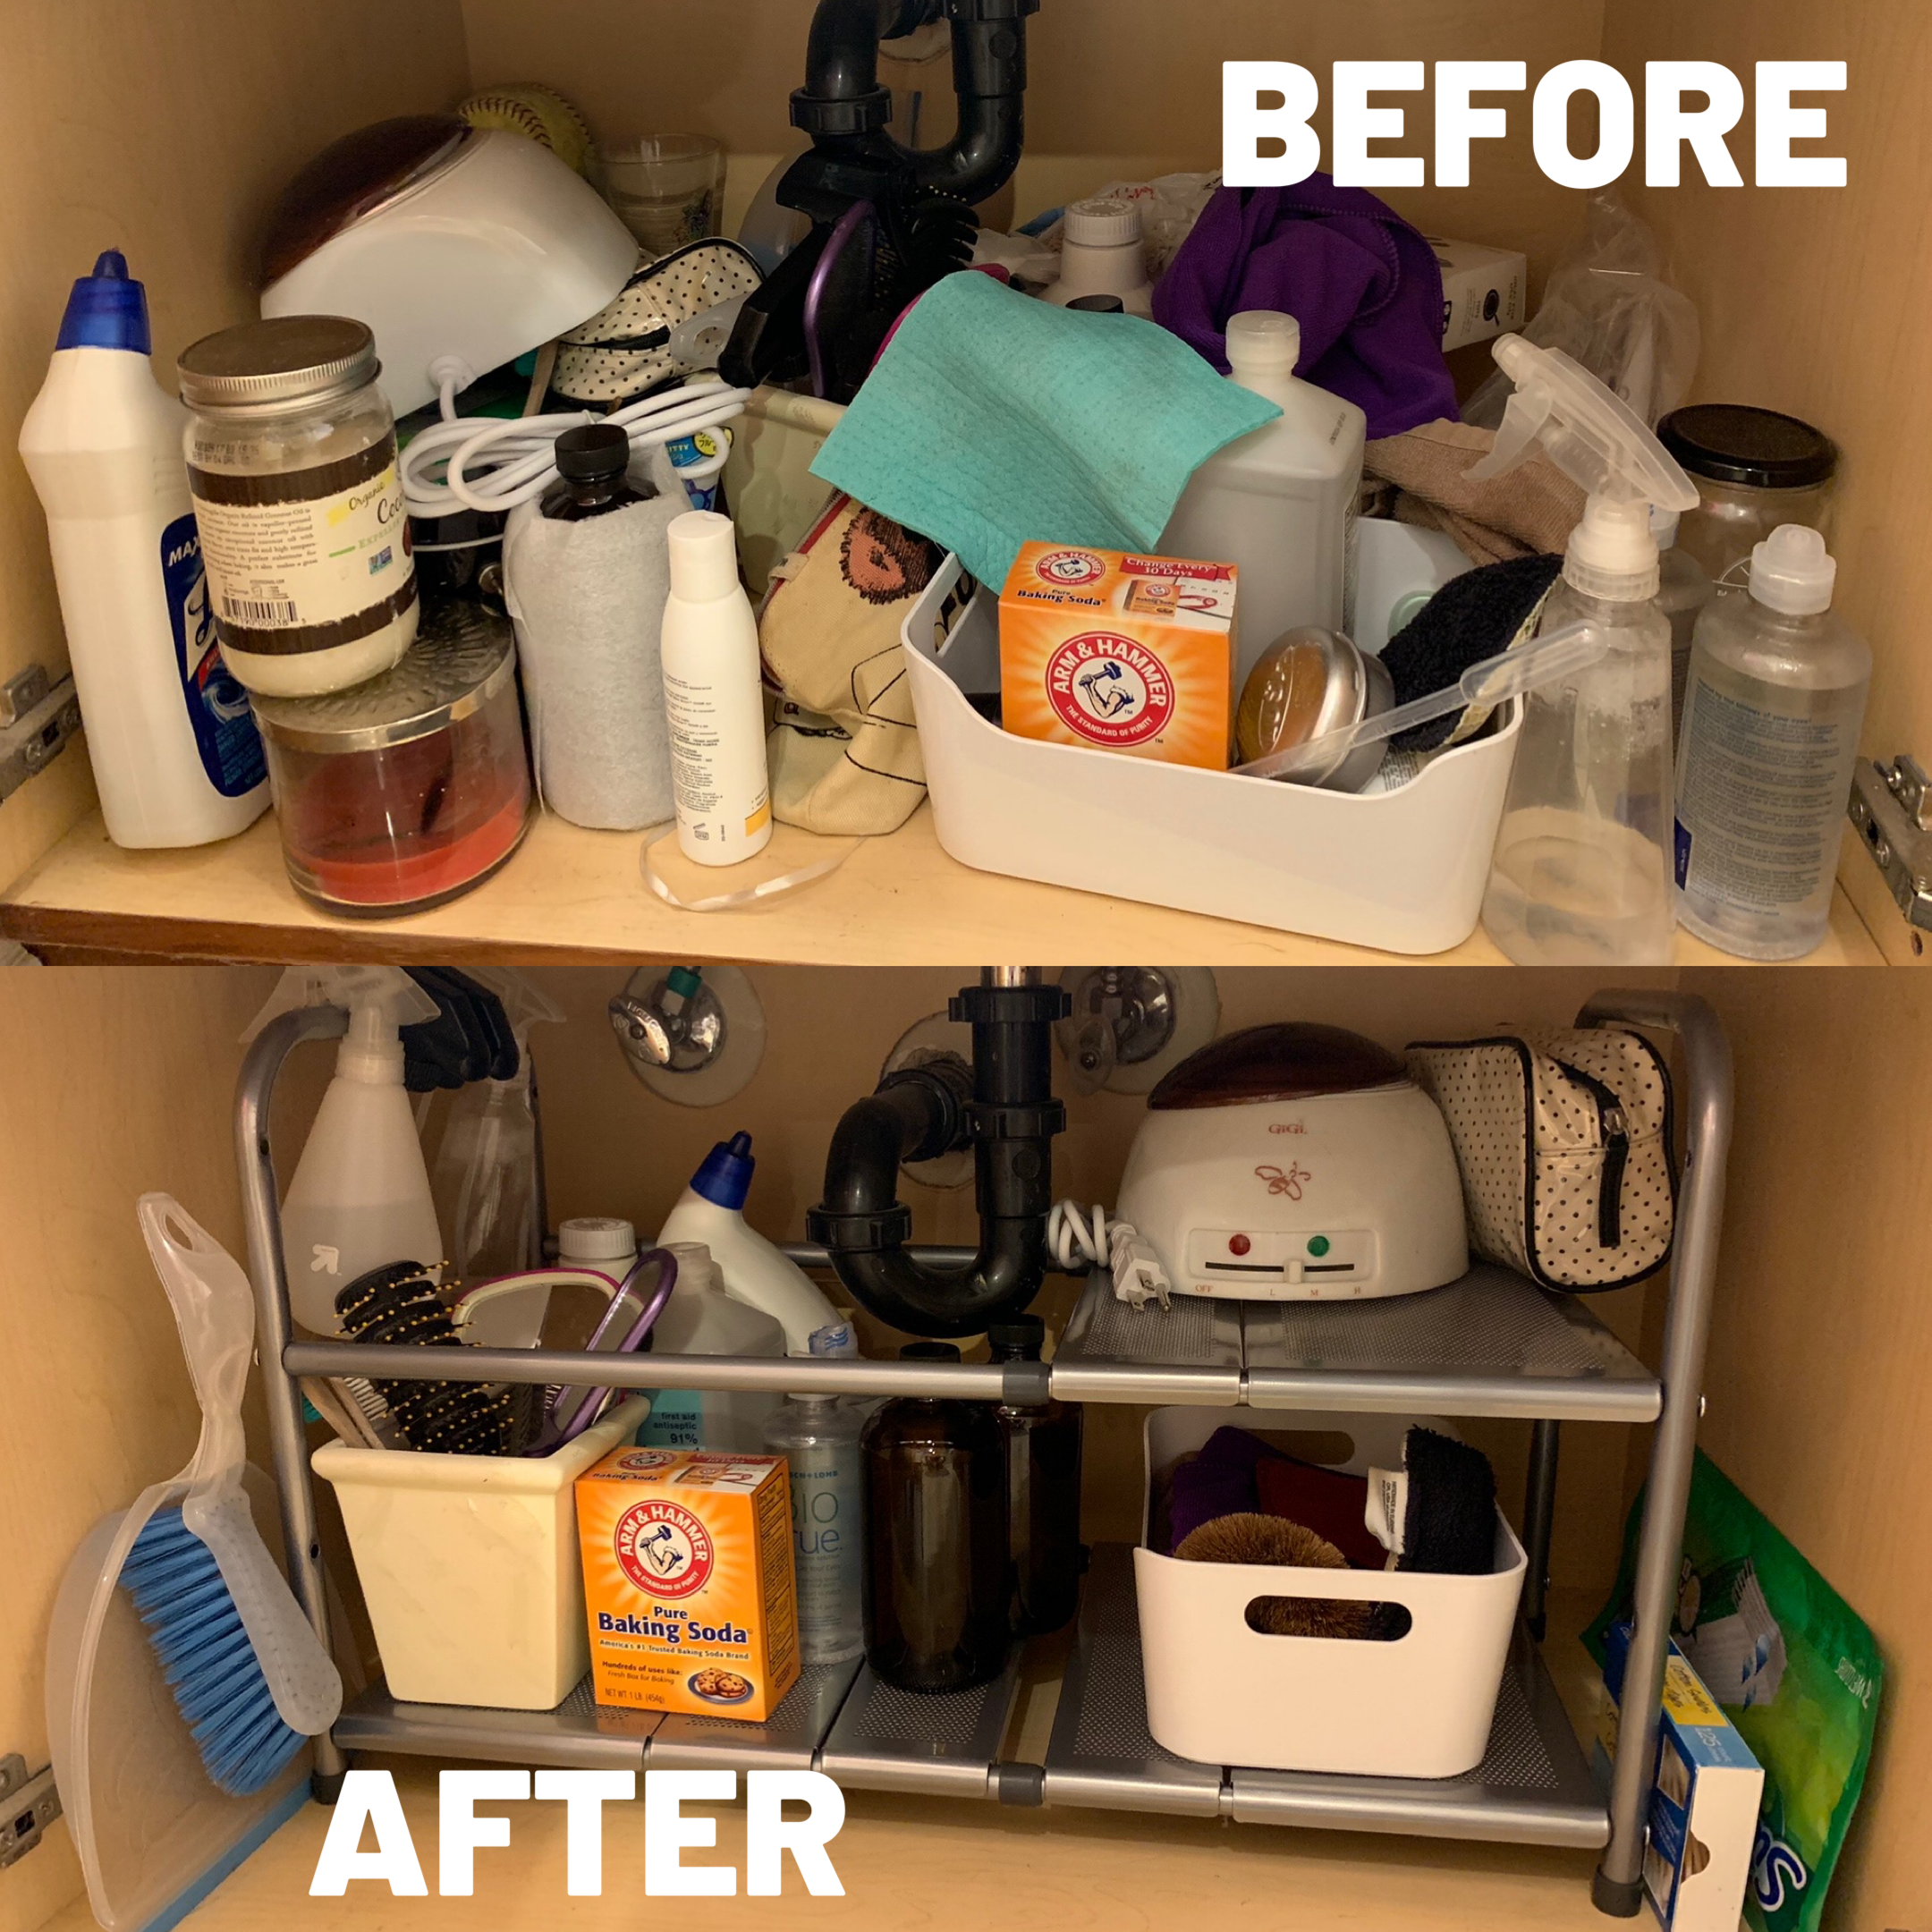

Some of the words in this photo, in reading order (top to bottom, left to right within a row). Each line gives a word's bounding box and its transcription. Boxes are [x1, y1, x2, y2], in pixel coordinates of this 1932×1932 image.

[349, 482, 386, 509] Organic
[1040, 555, 1058, 570] ARM
[1126, 556, 1174, 569] Change
[1177, 563, 1211, 572] Every
[1143, 566, 1158, 574] 30
[1163, 568, 1193, 577] Days
[1017, 589, 1063, 604] Baking
[1053, 650, 1080, 695] ARM
[1077, 641, 1096, 659] &
[1097, 639, 1167, 707] HAMMER
[1065, 704, 1078, 720] THE
[1077, 717, 1118, 737] STANDARD
[1130, 716, 1154, 735] PURITY
[1195, 1284, 1214, 1292] OFF
[1354, 1287, 1361, 1295] H
[662, 1412, 679, 1420] first
[653, 1421, 697, 1430] antiseptic
[670, 1433, 698, 1444] 91%
[620, 1518, 640, 1556] ARM
[635, 1510, 650, 1524] &
[650, 1505, 708, 1562] HAMMER
[654, 1606, 688, 1620] Pure
[597, 1612, 681, 1644] Baking
[599, 1640, 634, 1649] America's
[648, 1645, 675, 1654] Trusted
[677, 1648, 703, 1657] Baking
[705, 1650, 724, 1658] Soda
[726, 1652, 749, 1660] Brand
[602, 1660, 637, 1671] Hundreds
[638, 1664, 647, 1672] of
[648, 1666, 665, 1674] uses
[667, 1668, 683, 1676] like:
[607, 1670, 625, 1678] Fresh
[626, 1672, 639, 1680] Box
[640, 1673, 649, 1681] for
[651, 1675, 675, 1685] Baking
[605, 1688, 616, 1698] NET
[634, 1691, 642, 1700] LB
